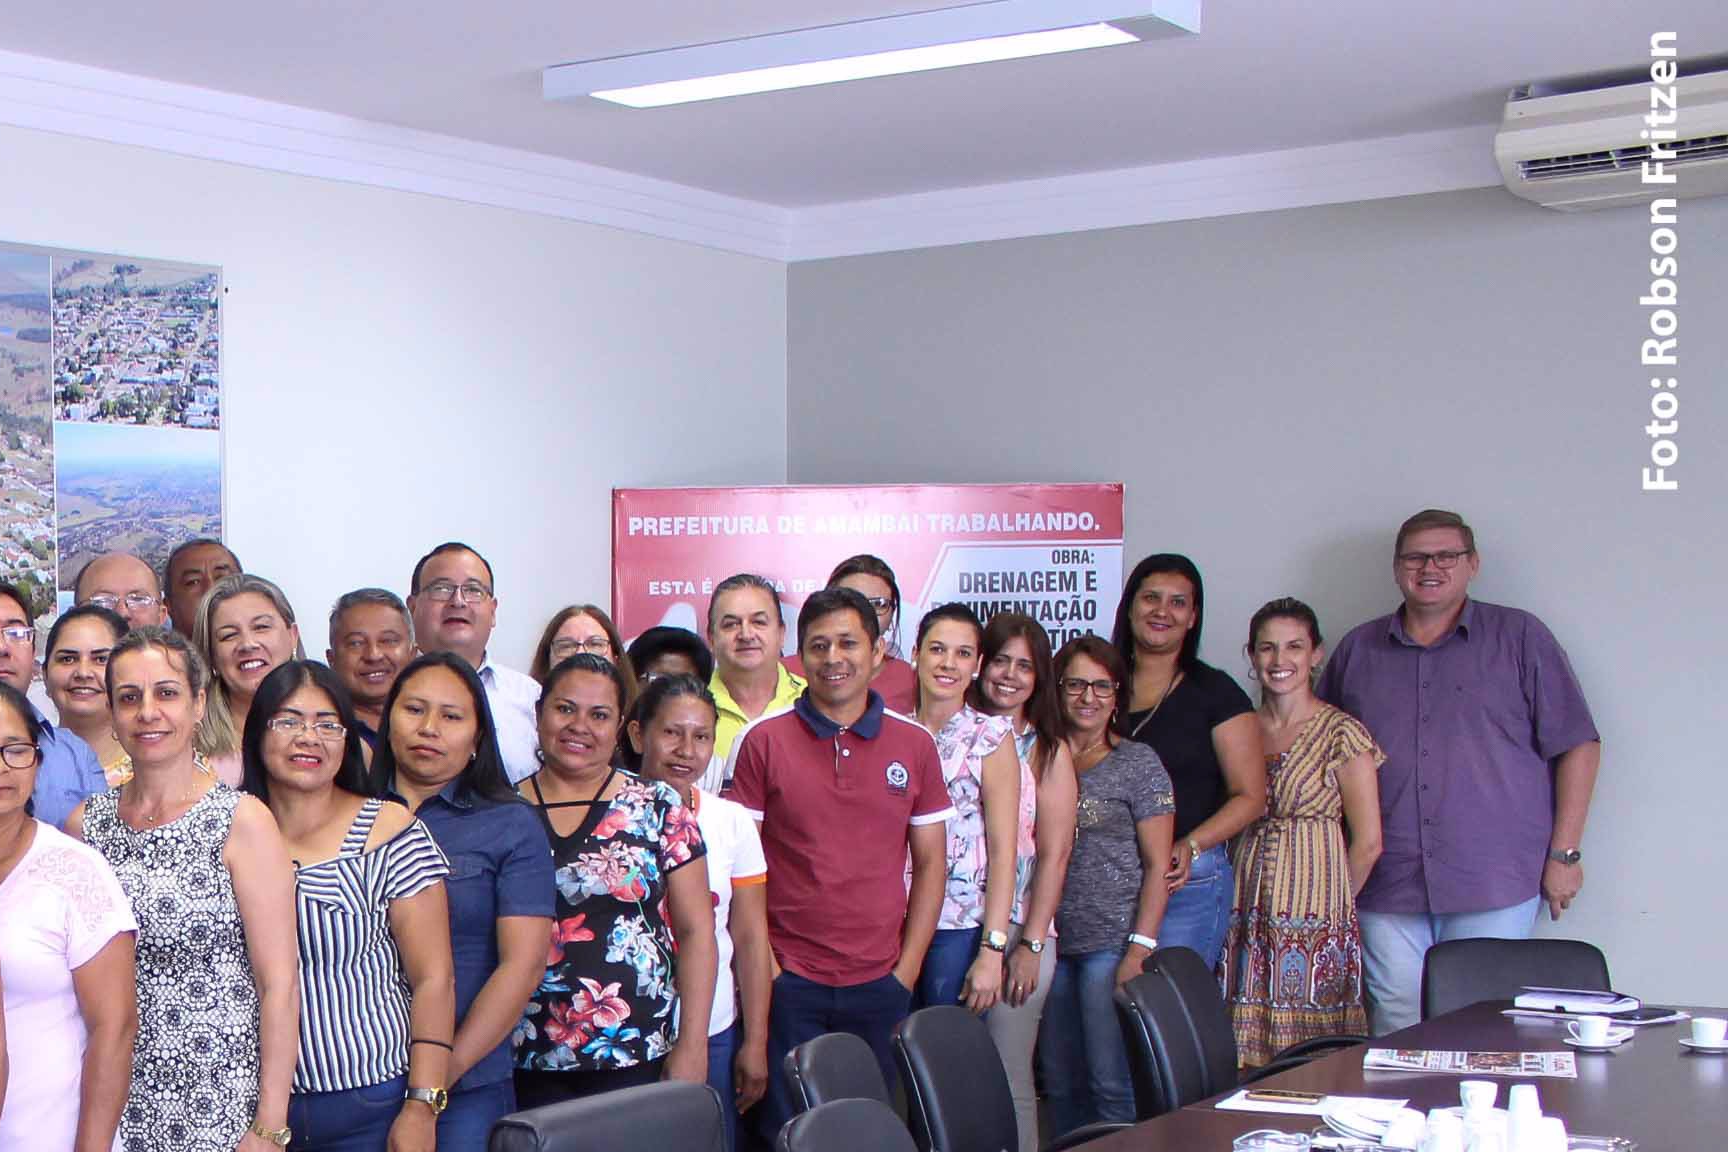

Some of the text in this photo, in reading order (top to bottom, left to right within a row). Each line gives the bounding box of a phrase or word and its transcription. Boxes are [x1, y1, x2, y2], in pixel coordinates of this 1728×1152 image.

[628, 511, 1100, 536] PREFEITURA DE AMAMBAI TRABALHANDO.
[1051, 549, 1096, 565] OBRA:
[648, 580, 696, 596] ESTA
[701, 577, 712, 595] É
[958, 570, 1098, 594] DRENAGEM E
